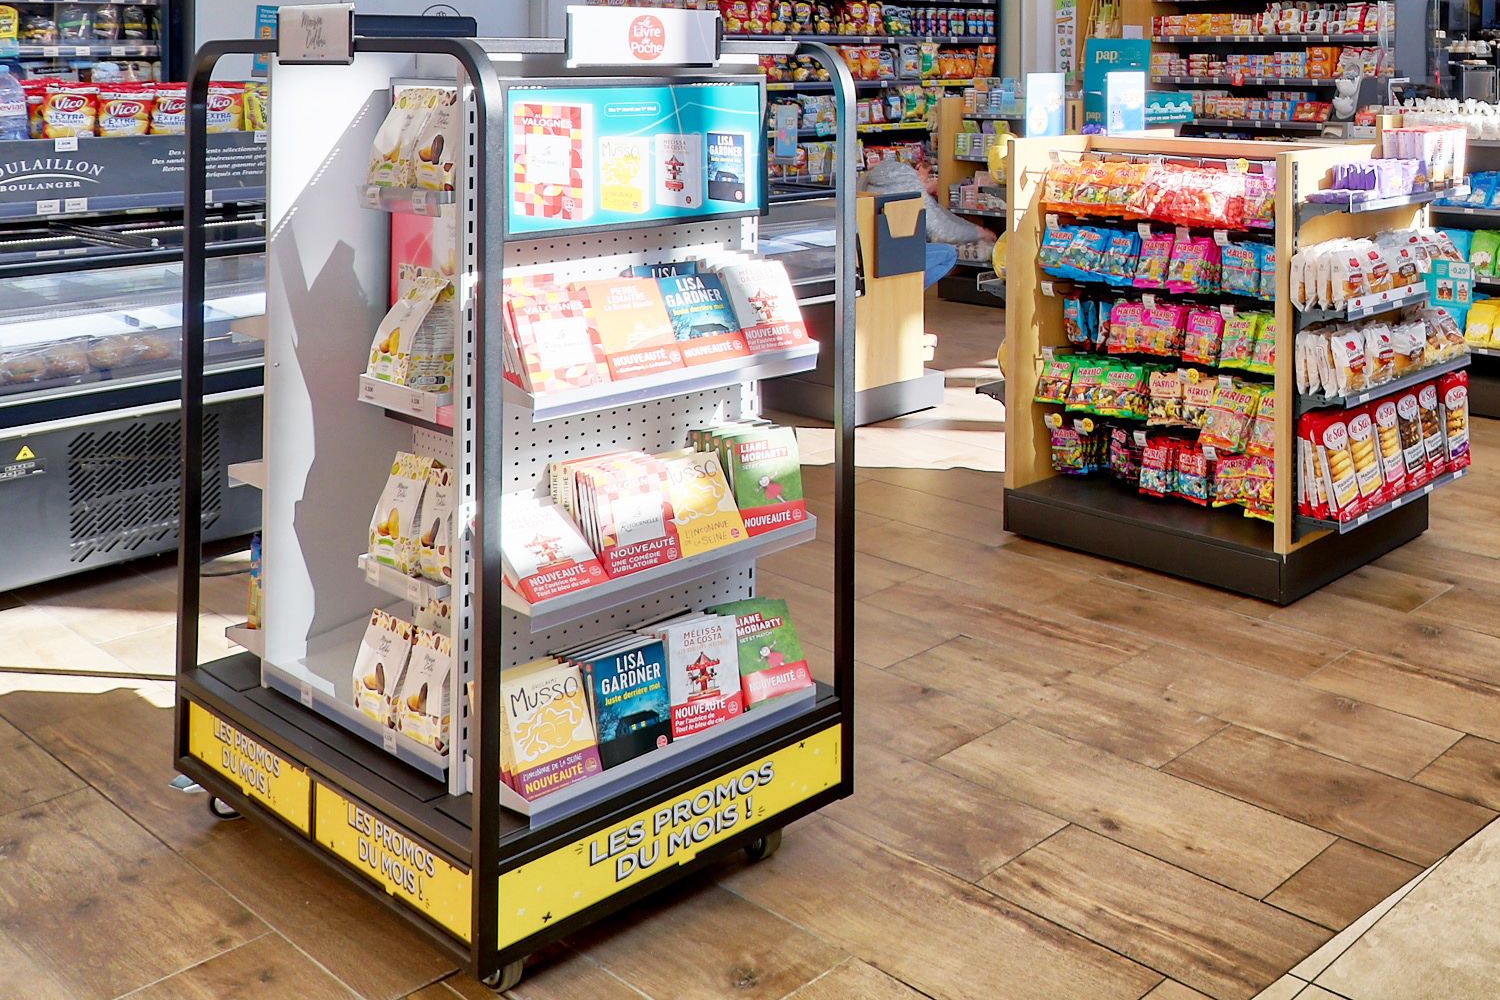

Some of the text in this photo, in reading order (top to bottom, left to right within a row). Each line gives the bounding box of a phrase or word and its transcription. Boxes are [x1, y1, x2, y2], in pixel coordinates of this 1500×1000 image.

[638, 16, 652, 28] Le
[633, 25, 661, 38] Livre
[630, 41, 663, 55] Poche
[641, 37, 651, 45] de
[0, 103, 24, 111] evian
[55, 97, 84, 109] Vico
[109, 101, 142, 117] Vico
[521, 117, 573, 129] VALOGNES
[717, 135, 734, 146] LISA
[602, 141, 640, 158] MUSSO
[709, 145, 742, 157] GARDNER
[0, 181, 81, 193] BOULANGER
[610, 285, 637, 296] PIERRE
[675, 276, 705, 290] LISA
[665, 288, 723, 307] GARDNER
[523, 300, 585, 315] VALOGNES
[745, 322, 791, 339] NOUVEAUTÉ
[612, 349, 667, 367] NOUVEAUTÉ
[684, 340, 732, 359] NOUVEAUTÉ
[1217, 390, 1252, 404] HARIBO
[740, 440, 768, 453] LIANE
[741, 447, 787, 463] MORIARTY
[603, 473, 661, 492] VALOGNES
[620, 516, 660, 533] RITOURNELLE
[744, 509, 791, 528] NOUVEAUTÉ
[684, 519, 729, 539] L'INCONNUE
[701, 530, 728, 544] SEINE
[610, 535, 676, 559] NOUVEAUTÉ
[611, 550, 661, 567] UNE COMÉDIE
[612, 557, 659, 574] JUBILATOIRE
[528, 563, 586, 587] NOUVEAUTÉ
[735, 613, 761, 628] LIANE
[737, 617, 782, 637] MORIARTY
[683, 625, 722, 640] MÉLISSA
[683, 632, 722, 647] DA COSTA
[615, 650, 645, 672] LISA
[601, 662, 661, 695] GARDNER
[749, 671, 796, 693] NOUVEAUTÉ
[509, 675, 579, 718] MUSSO
[604, 682, 661, 706] Juste derrière moi
[675, 697, 727, 720] NOUVEAUTÉ
[675, 718, 685, 727] Par
[686, 714, 707, 725] l'autrice
[675, 724, 688, 733] Tout
[694, 721, 705, 729] bleu
[714, 715, 726, 724] ciel
[213, 716, 280, 778] LES PROMOS
[221, 747, 238, 774] DU
[239, 756, 266, 794] MOIS
[524, 763, 584, 795] NOUVEAUTÉ
[589, 761, 775, 867] LES PROMOS
[347, 802, 435, 878] LES PROMOS
[616, 839, 660, 882] DU
[667, 803, 739, 857] MOIS
[358, 837, 378, 868] DU
[381, 851, 416, 895] MOIS
